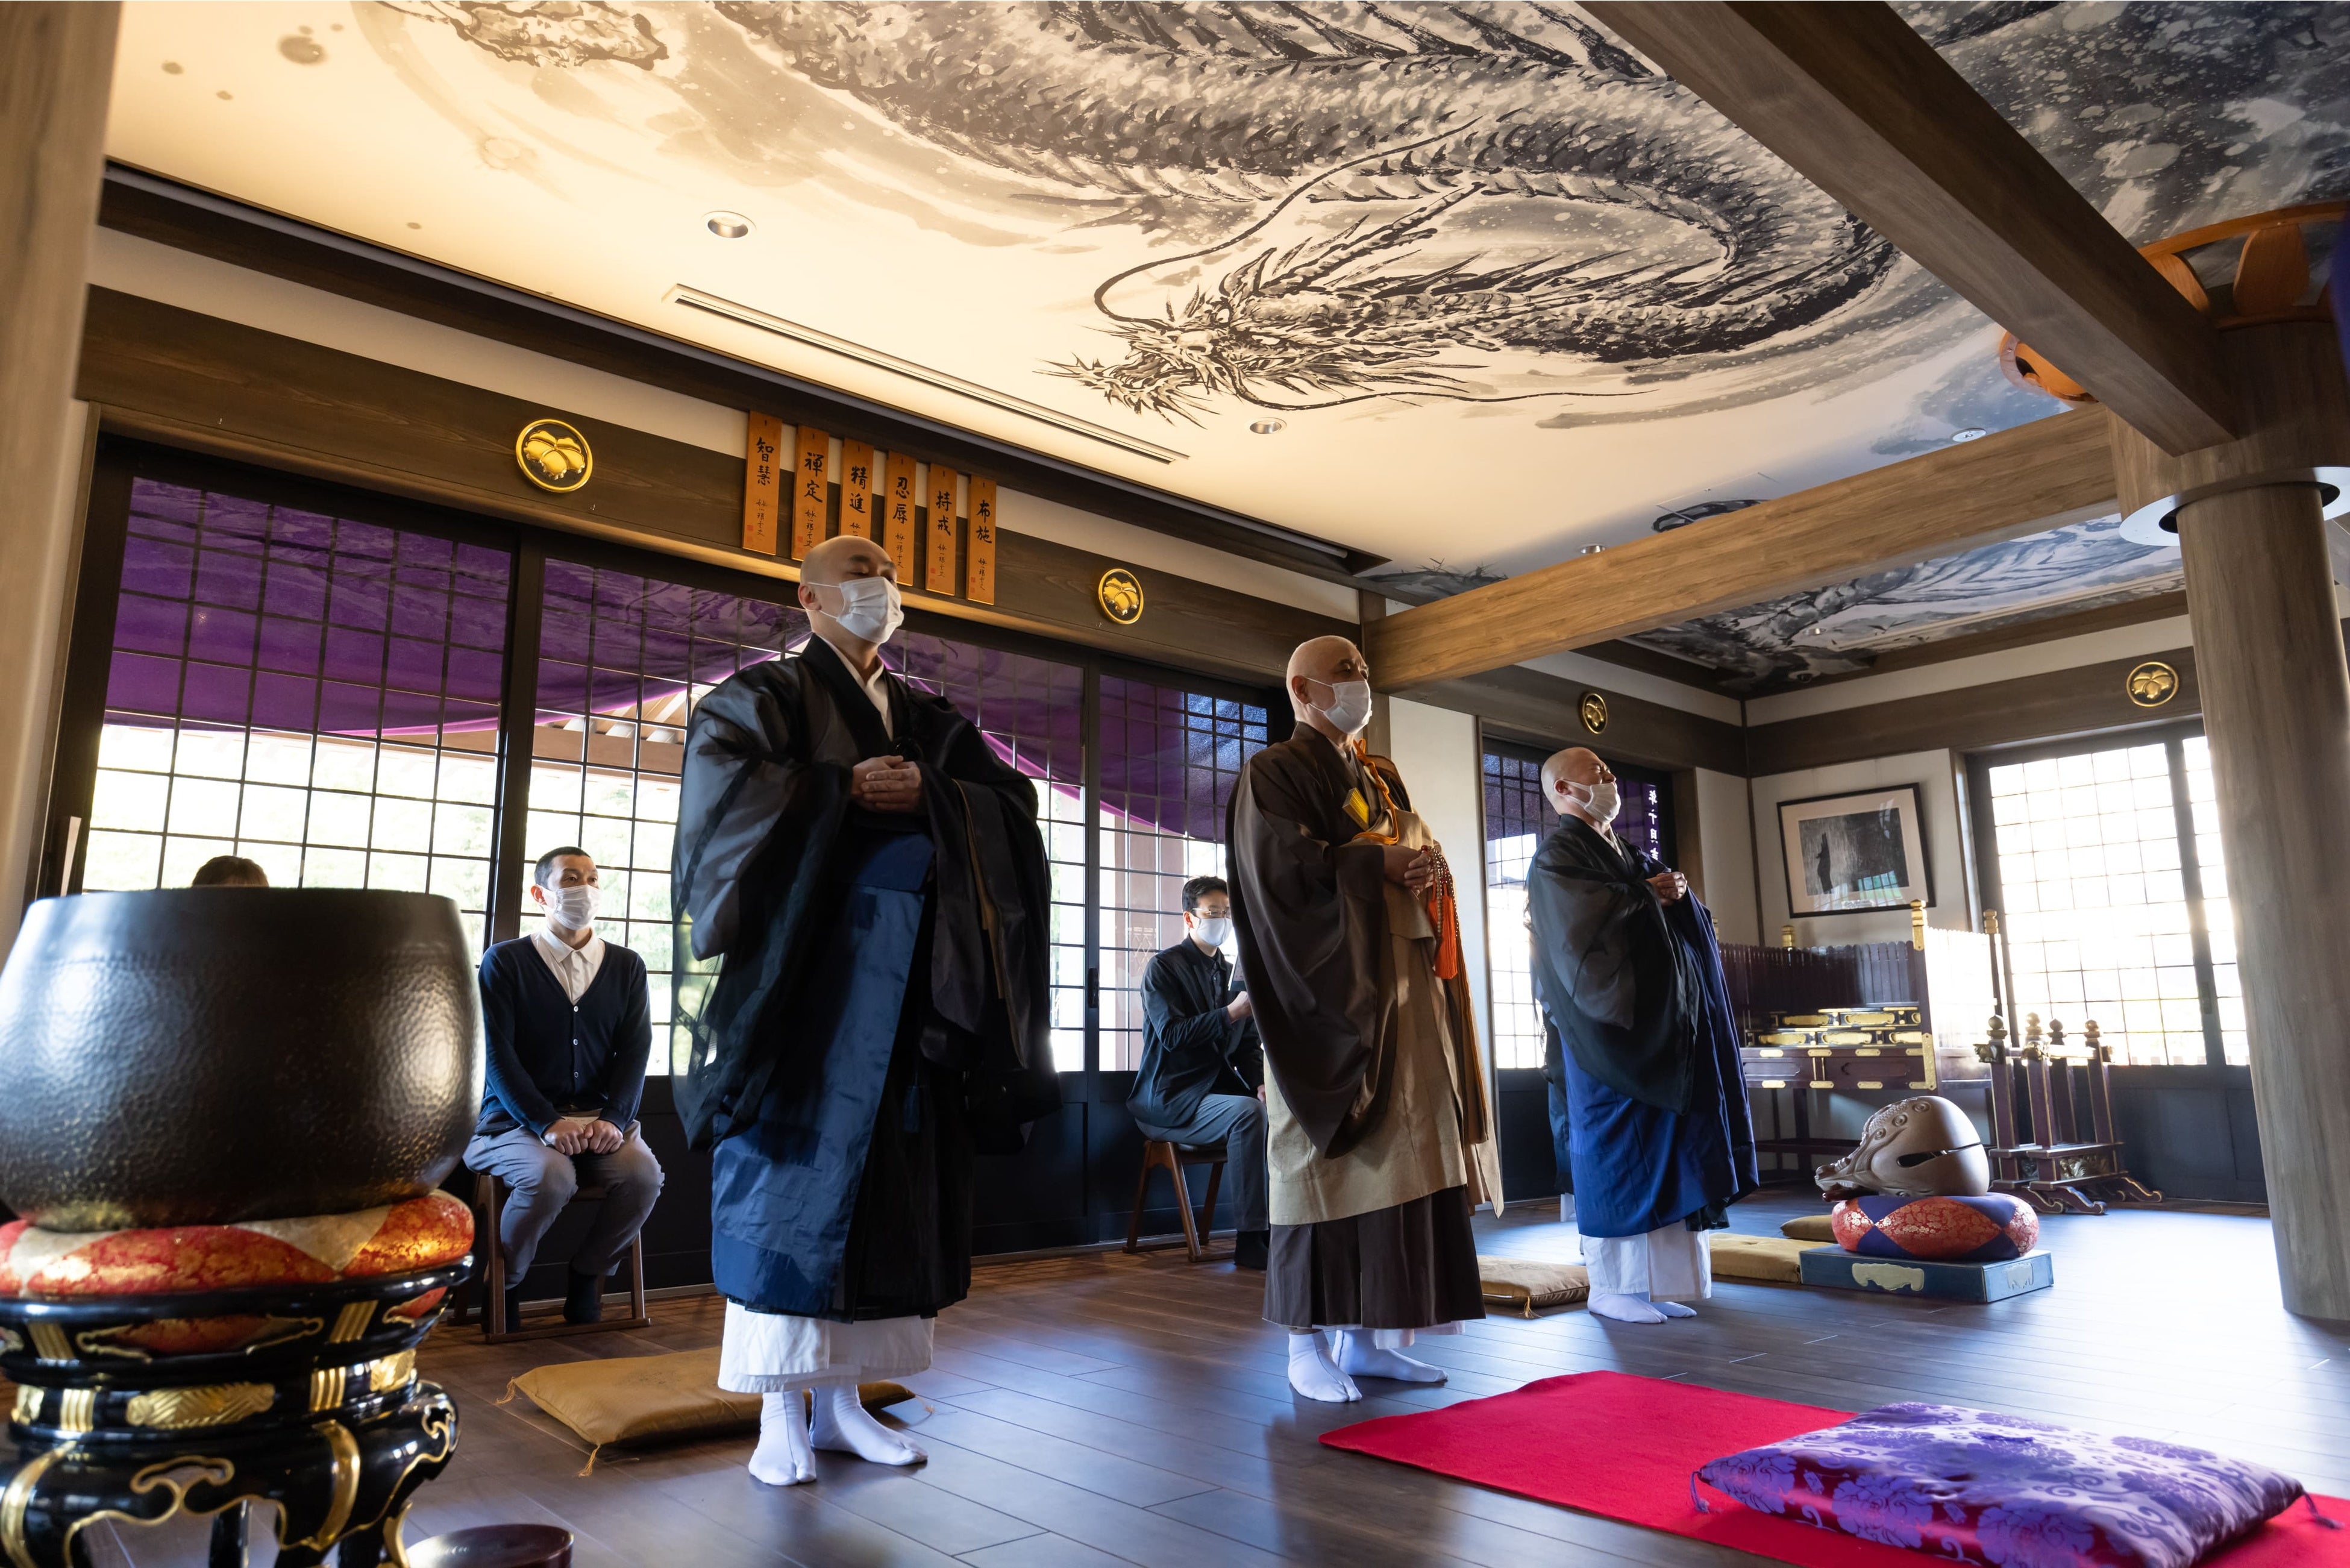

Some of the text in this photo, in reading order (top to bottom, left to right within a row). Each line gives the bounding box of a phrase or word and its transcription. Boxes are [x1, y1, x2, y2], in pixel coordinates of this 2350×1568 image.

[850, 465, 868, 513] 精進
[893, 477, 910, 524] 忍辱
[936, 491, 952, 536] 持戒
[976, 500, 992, 544] 布施
